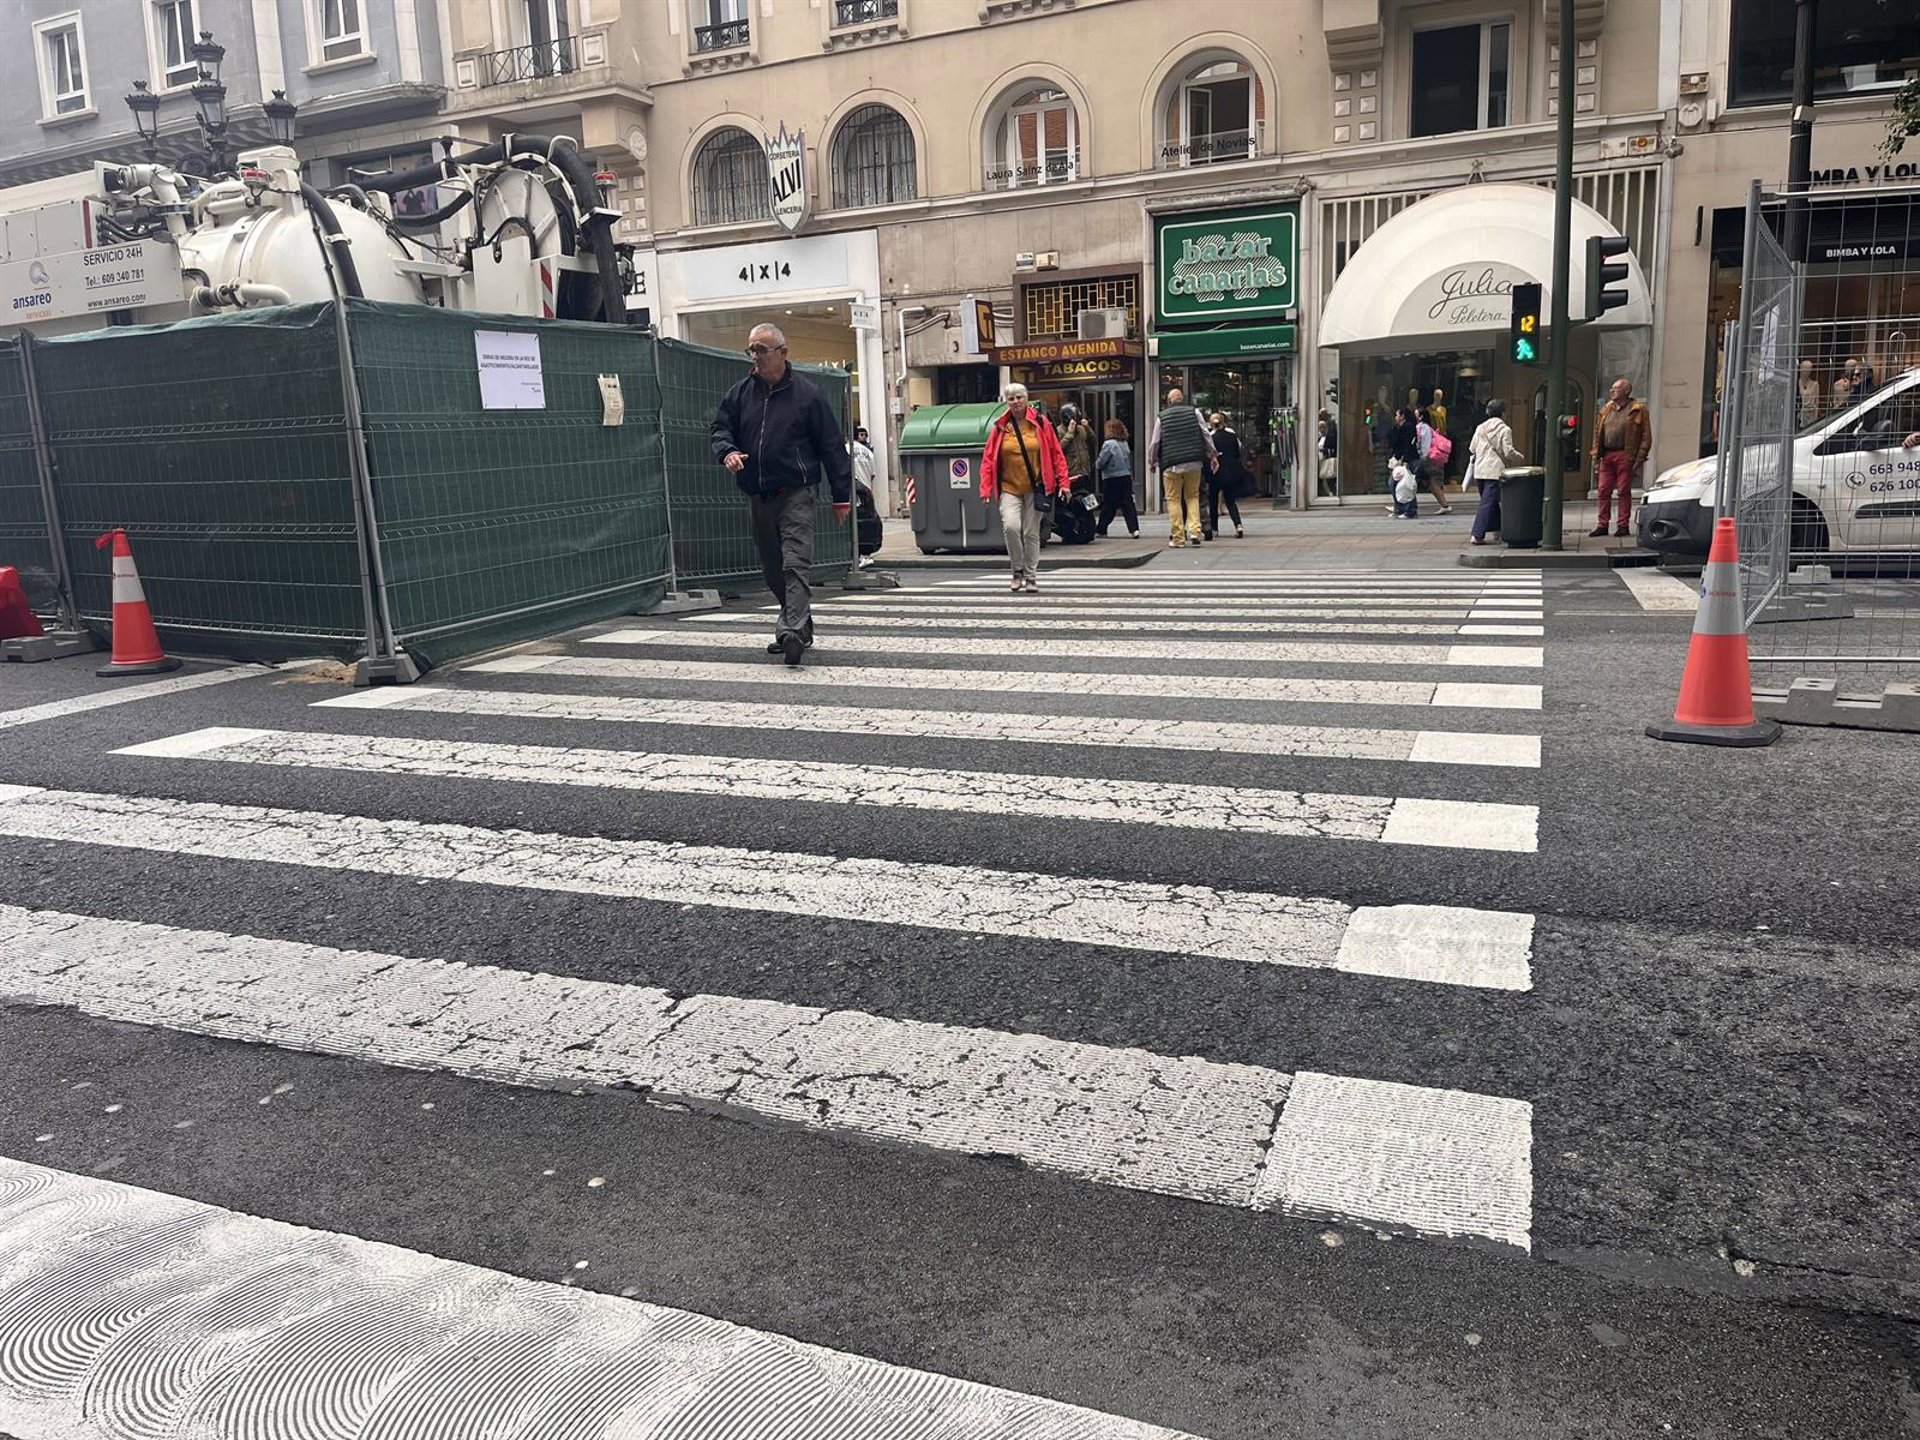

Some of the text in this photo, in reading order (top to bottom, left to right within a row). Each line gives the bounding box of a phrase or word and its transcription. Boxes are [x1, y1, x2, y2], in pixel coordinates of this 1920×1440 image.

[1200, 142, 1213, 152] de
[1217, 137, 1256, 150] Novias
[986, 169, 1013, 180] Laura
[1016, 166, 1042, 176] Sainz
[1865, 165, 1879, 182] Y
[772, 158, 801, 207] ALVI
[83, 247, 143, 267] SERVICIO 24H
[1182, 237, 1272, 265] bazar
[1826, 246, 1896, 258] BIMBA Y LOLA
[101, 273, 115, 285] 609
[131, 268, 145, 279] 781
[1168, 266, 1287, 295] canarias
[13, 292, 52, 310] ansareo
[1428, 268, 1513, 319] Julia
[1521, 315, 1535, 332] 12
[1001, 346, 1058, 361] ESTANCO
[1061, 341, 1117, 358] AVENIDA
[1042, 359, 1122, 376] TABACOS
[1869, 461, 1920, 475] 663 948
[1870, 480, 1894, 492] 626
